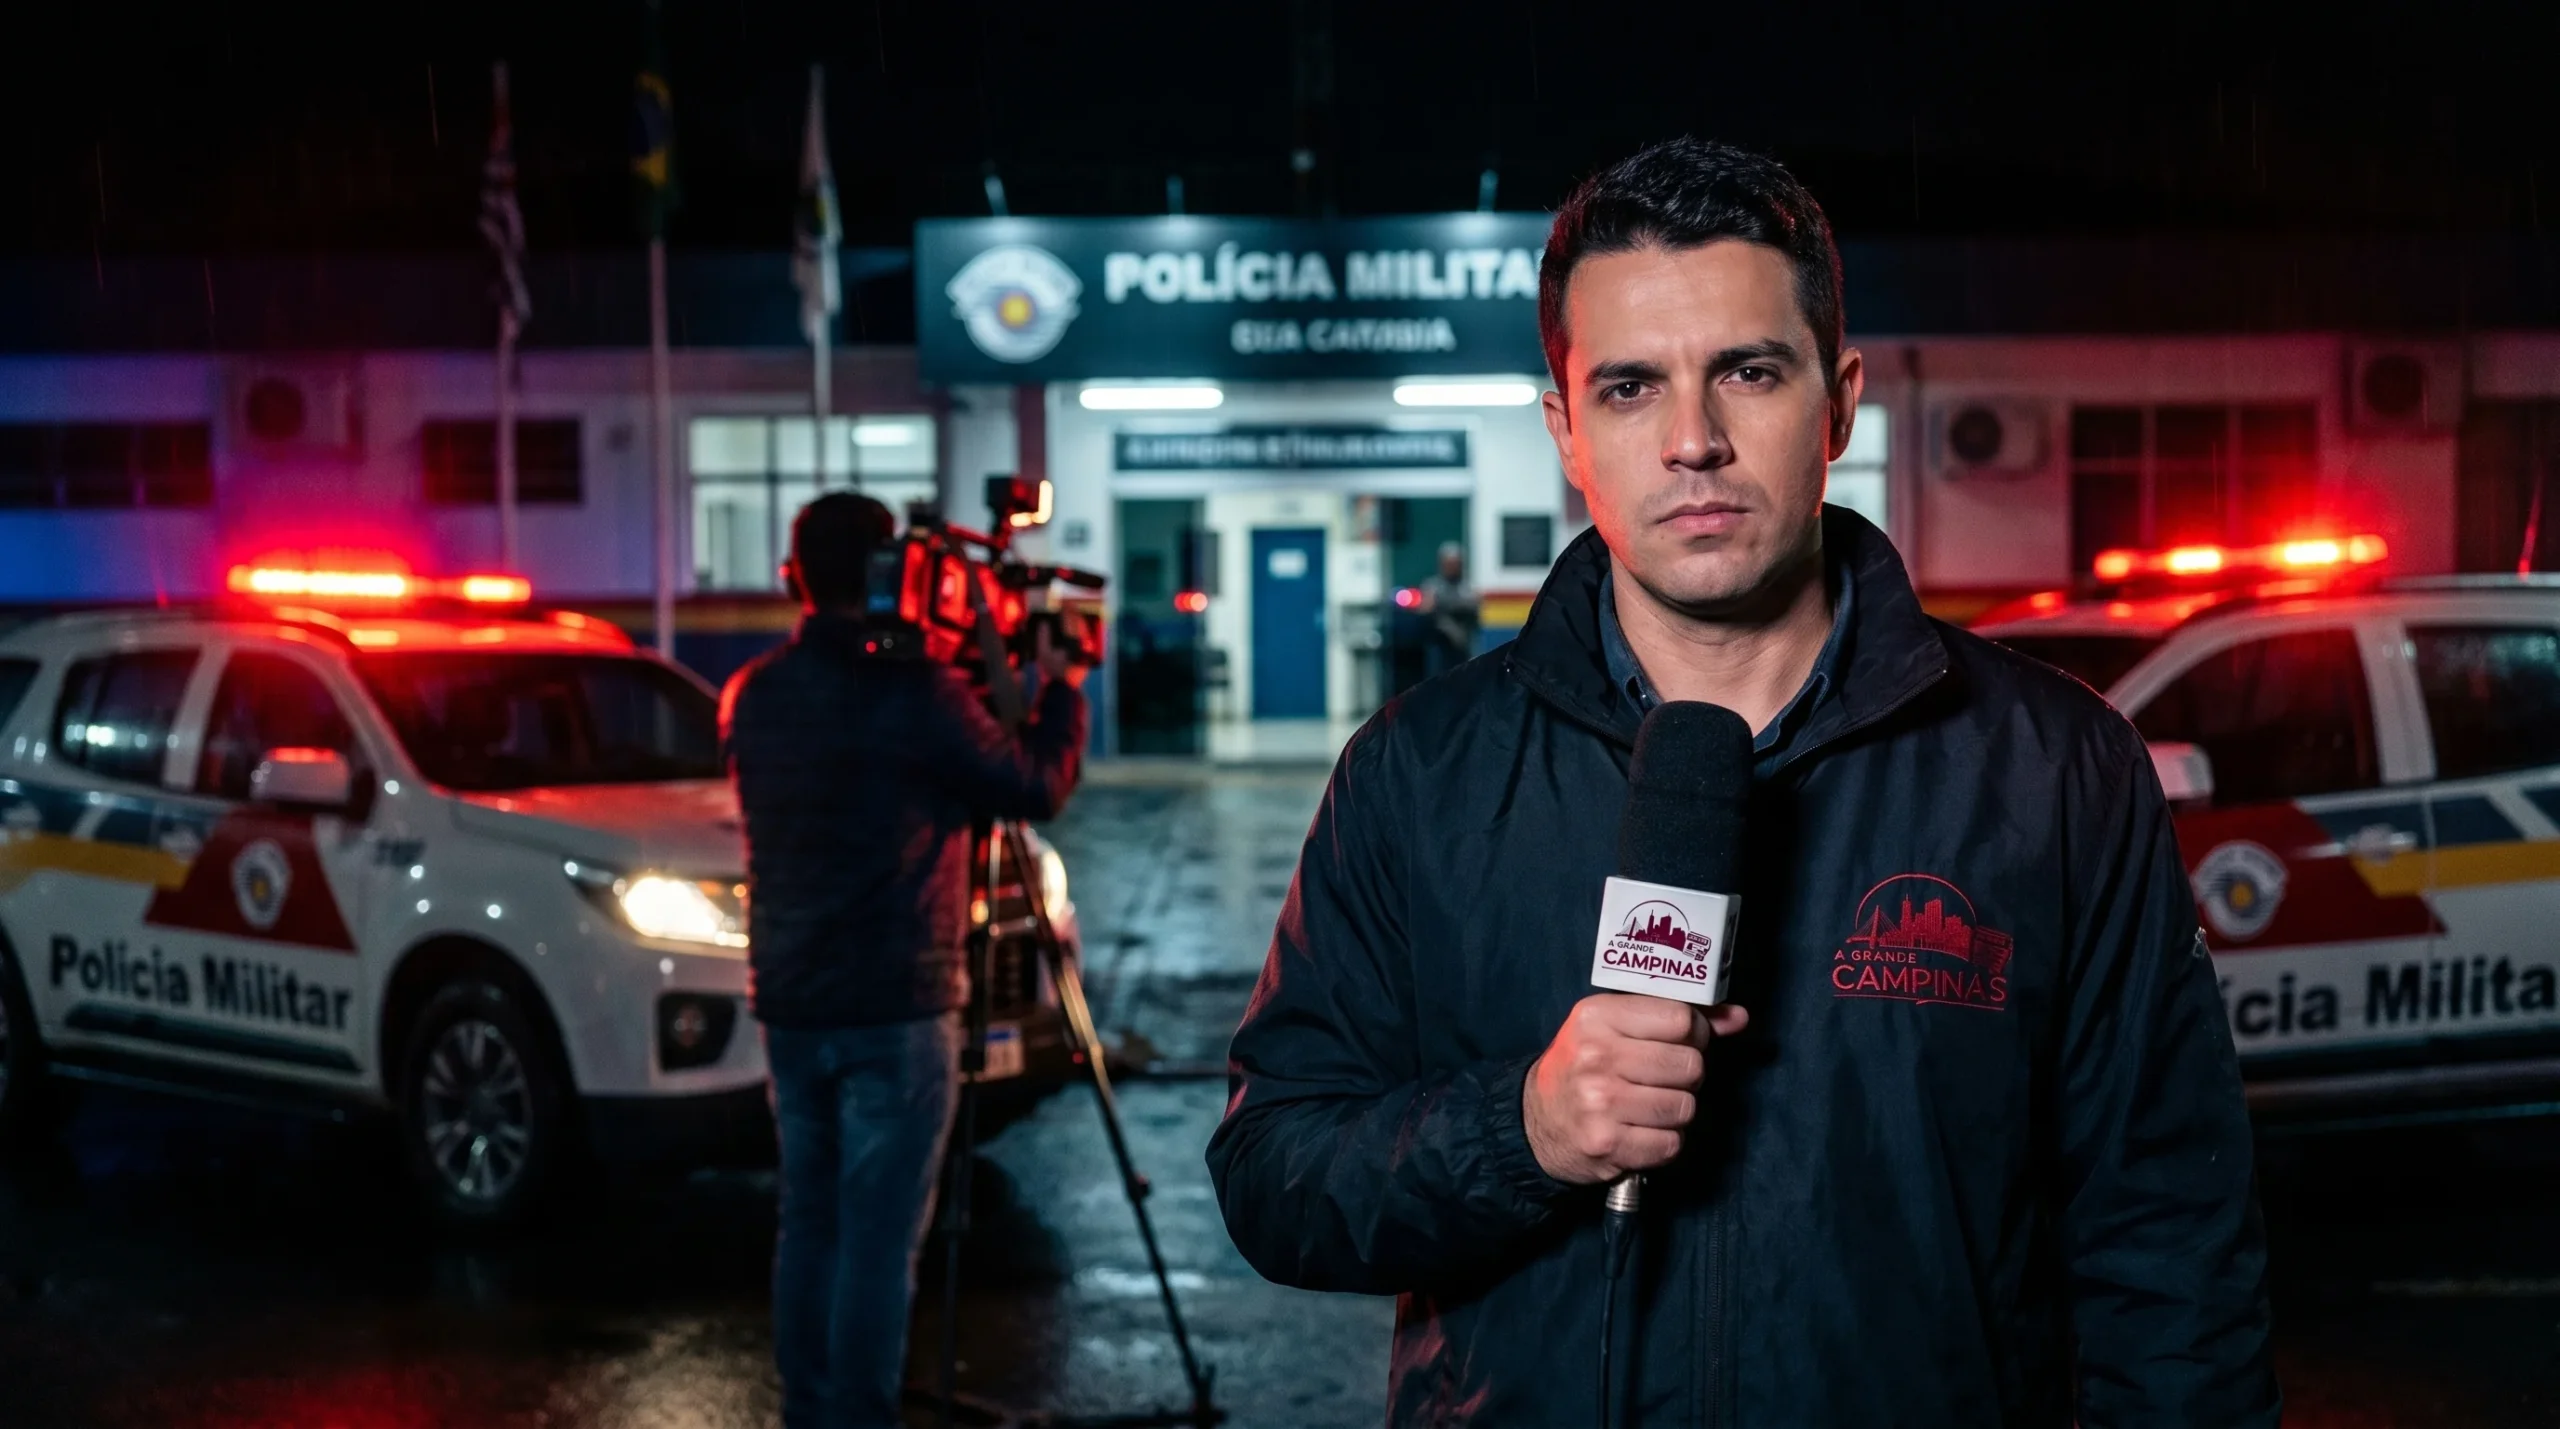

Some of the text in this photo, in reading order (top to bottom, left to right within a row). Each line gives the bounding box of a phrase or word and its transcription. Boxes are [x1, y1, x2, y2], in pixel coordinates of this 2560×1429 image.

[1105, 241, 1545, 301] POLÍCIA MILITA
[1603, 949, 1708, 980] CAMPINAS
[1617, 942, 1655, 954] GRANDE
[1834, 950, 1917, 964] A GRANDE
[51, 934, 353, 1030] Polícia Militar
[1832, 964, 2007, 1002] CAMPINAS
[2365, 954, 2556, 1025] Milita
